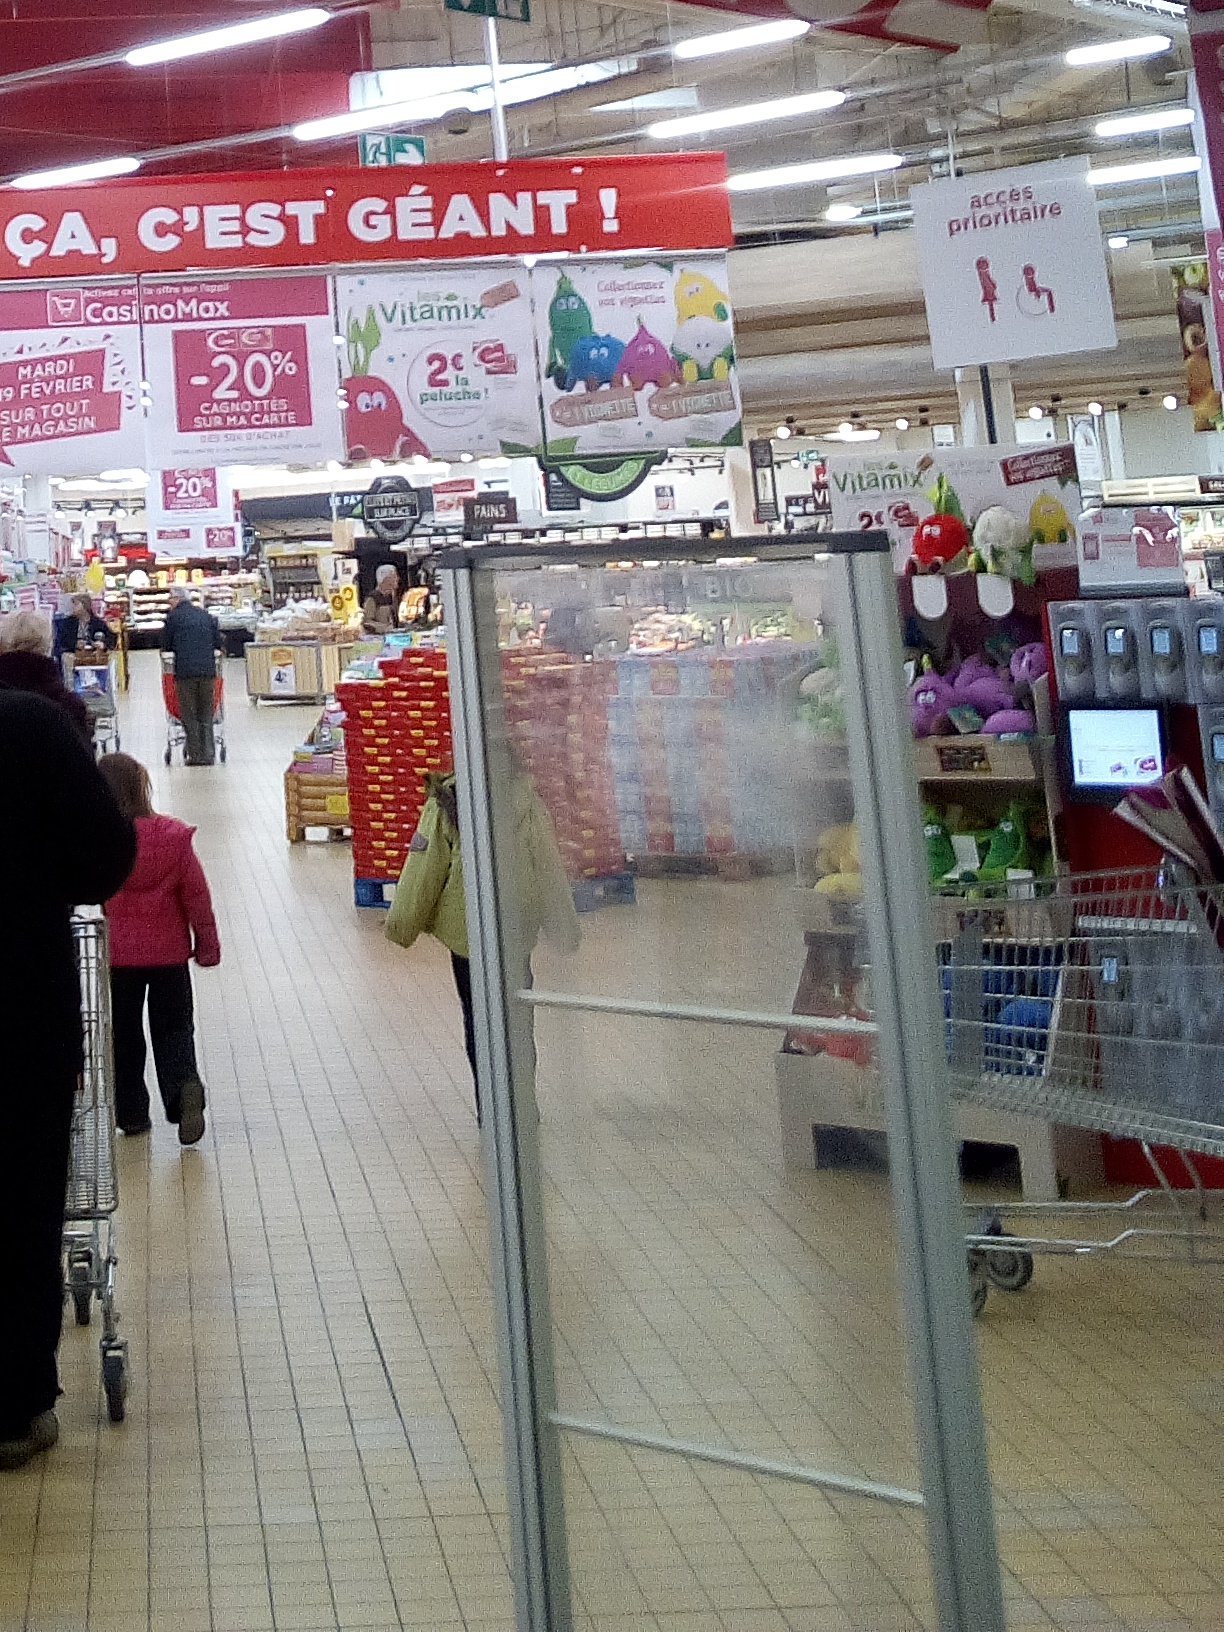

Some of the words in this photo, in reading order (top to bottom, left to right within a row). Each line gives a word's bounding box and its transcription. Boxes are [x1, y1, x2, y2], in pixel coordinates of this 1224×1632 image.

[4, 212, 118, 267] ÇA,
[137, 200, 326, 252] C'EST
[346, 183, 579, 242] GÉANT
[599, 187, 619, 233] !
[948, 201, 1062, 237] prioritaire
[85, 298, 231, 324] CasinoMax
[380, 300, 486, 326] Vitamix
[18, 358, 75, 380] MARDI
[189, 351, 298, 400] -20%
[20, 375, 94, 400] FÉVRIER
[419, 389, 482, 405] peluche
[0, 410, 39, 425] SUR
[41, 399, 90, 418] TOUT
[194, 416, 223, 428] SUR
[227, 415, 248, 426] MA
[251, 412, 297, 425] CARTE
[17, 417, 97, 439] MAGASIN
[832, 471, 923, 494] Vitamix
